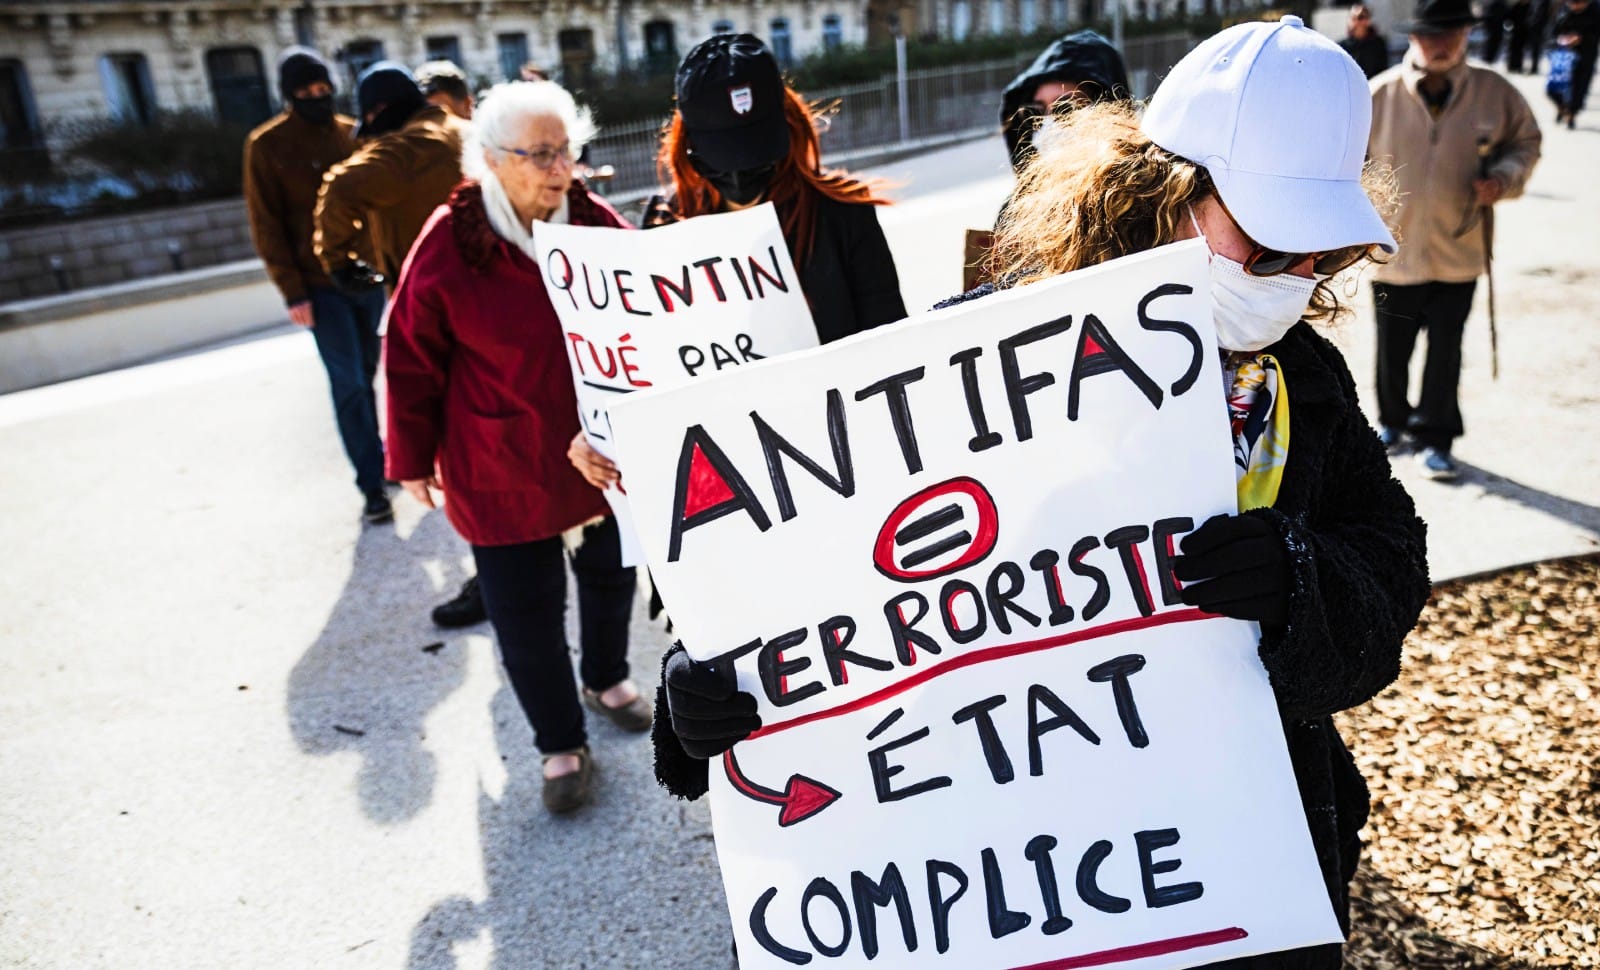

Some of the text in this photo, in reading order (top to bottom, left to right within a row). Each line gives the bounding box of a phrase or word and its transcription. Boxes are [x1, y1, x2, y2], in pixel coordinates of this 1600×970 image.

[547, 246, 789, 316] QUENTIN
[567, 332, 768, 387] TUÉ PAR
[668, 284, 1204, 562] ANTIFAS
[866, 654, 1150, 804] ÉTAT
[749, 828, 1204, 965] COMPLICE
